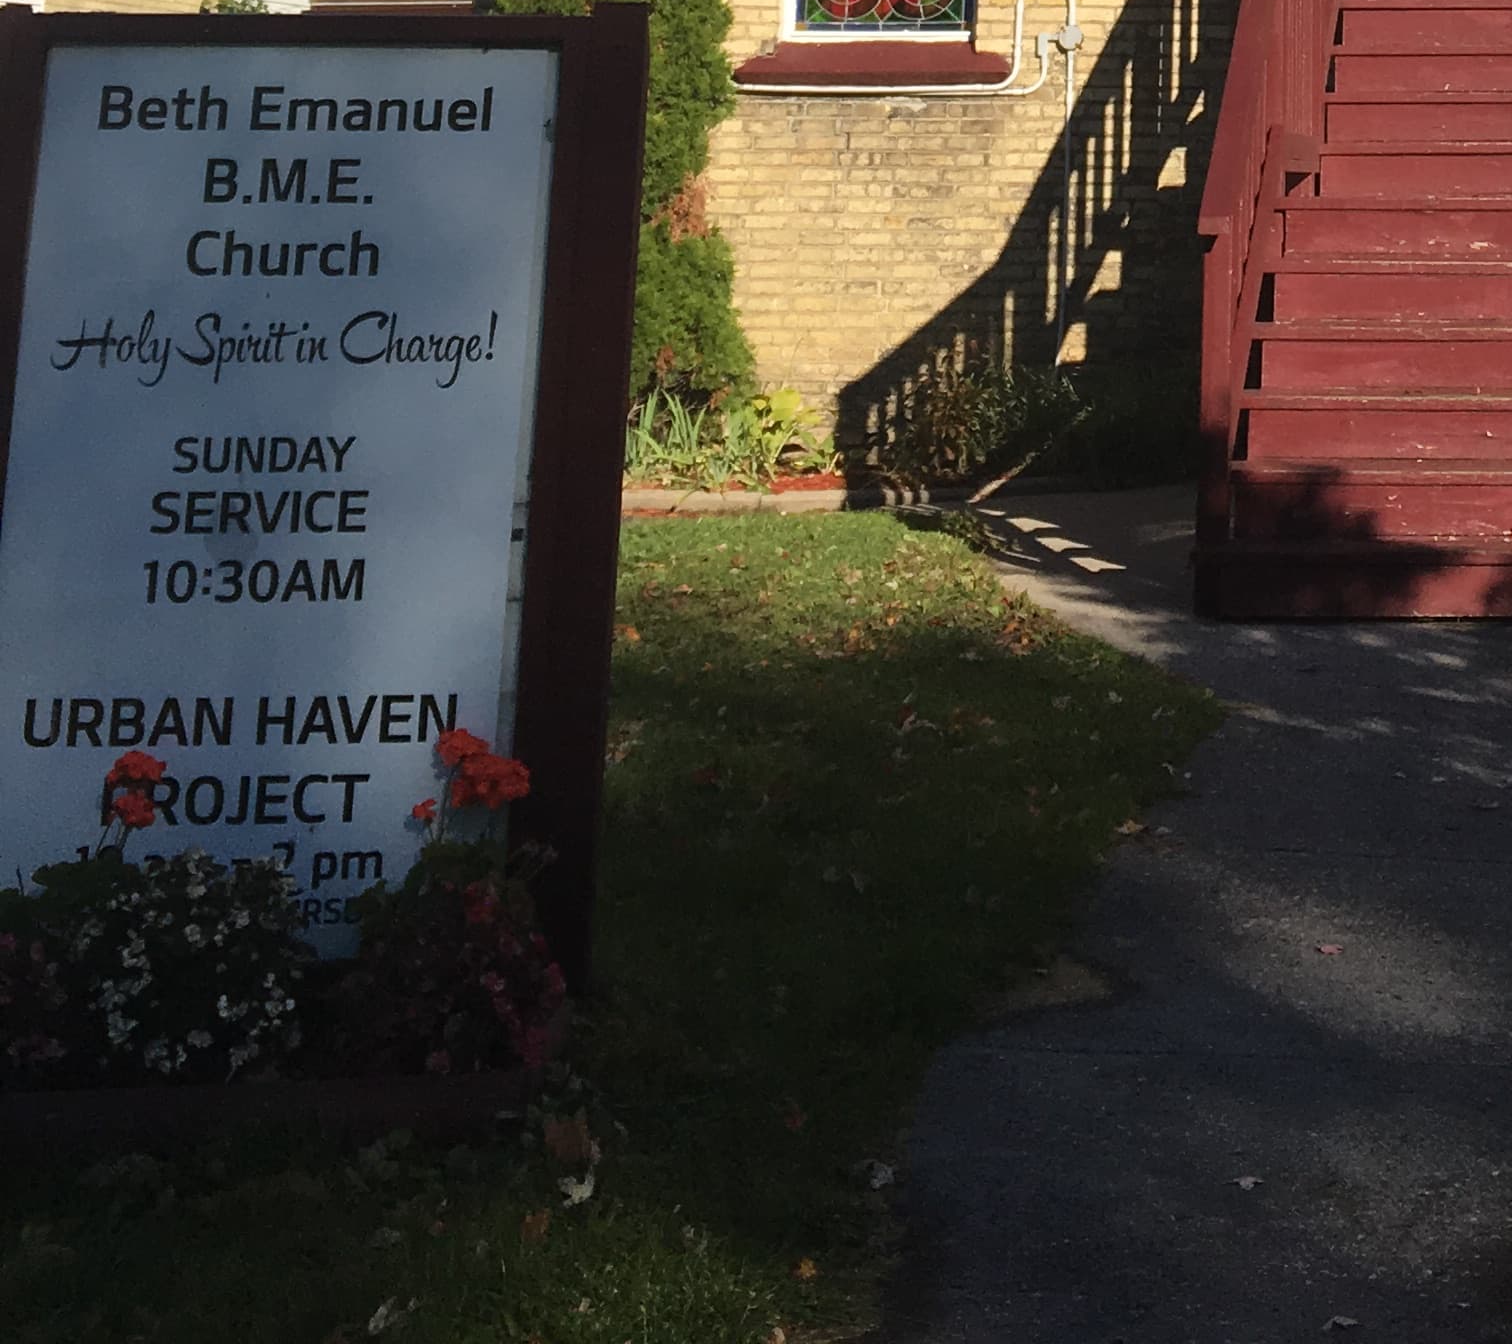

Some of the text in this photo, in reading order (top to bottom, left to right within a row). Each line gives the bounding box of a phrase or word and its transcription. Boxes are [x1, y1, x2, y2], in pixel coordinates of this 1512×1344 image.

[98, 85, 494, 132] Beth Emanuel
[203, 158, 373, 204] B.M.E.
[187, 230, 380, 276] Church
[50, 309, 498, 389] Holy Spirit in Charge!
[173, 437, 356, 473] SUNDAY
[149, 490, 370, 534] SERVICE
[144, 559, 366, 604] 10:30AM
[23, 693, 458, 747] URBAN HAVEN
[311, 849, 382, 889] pm
